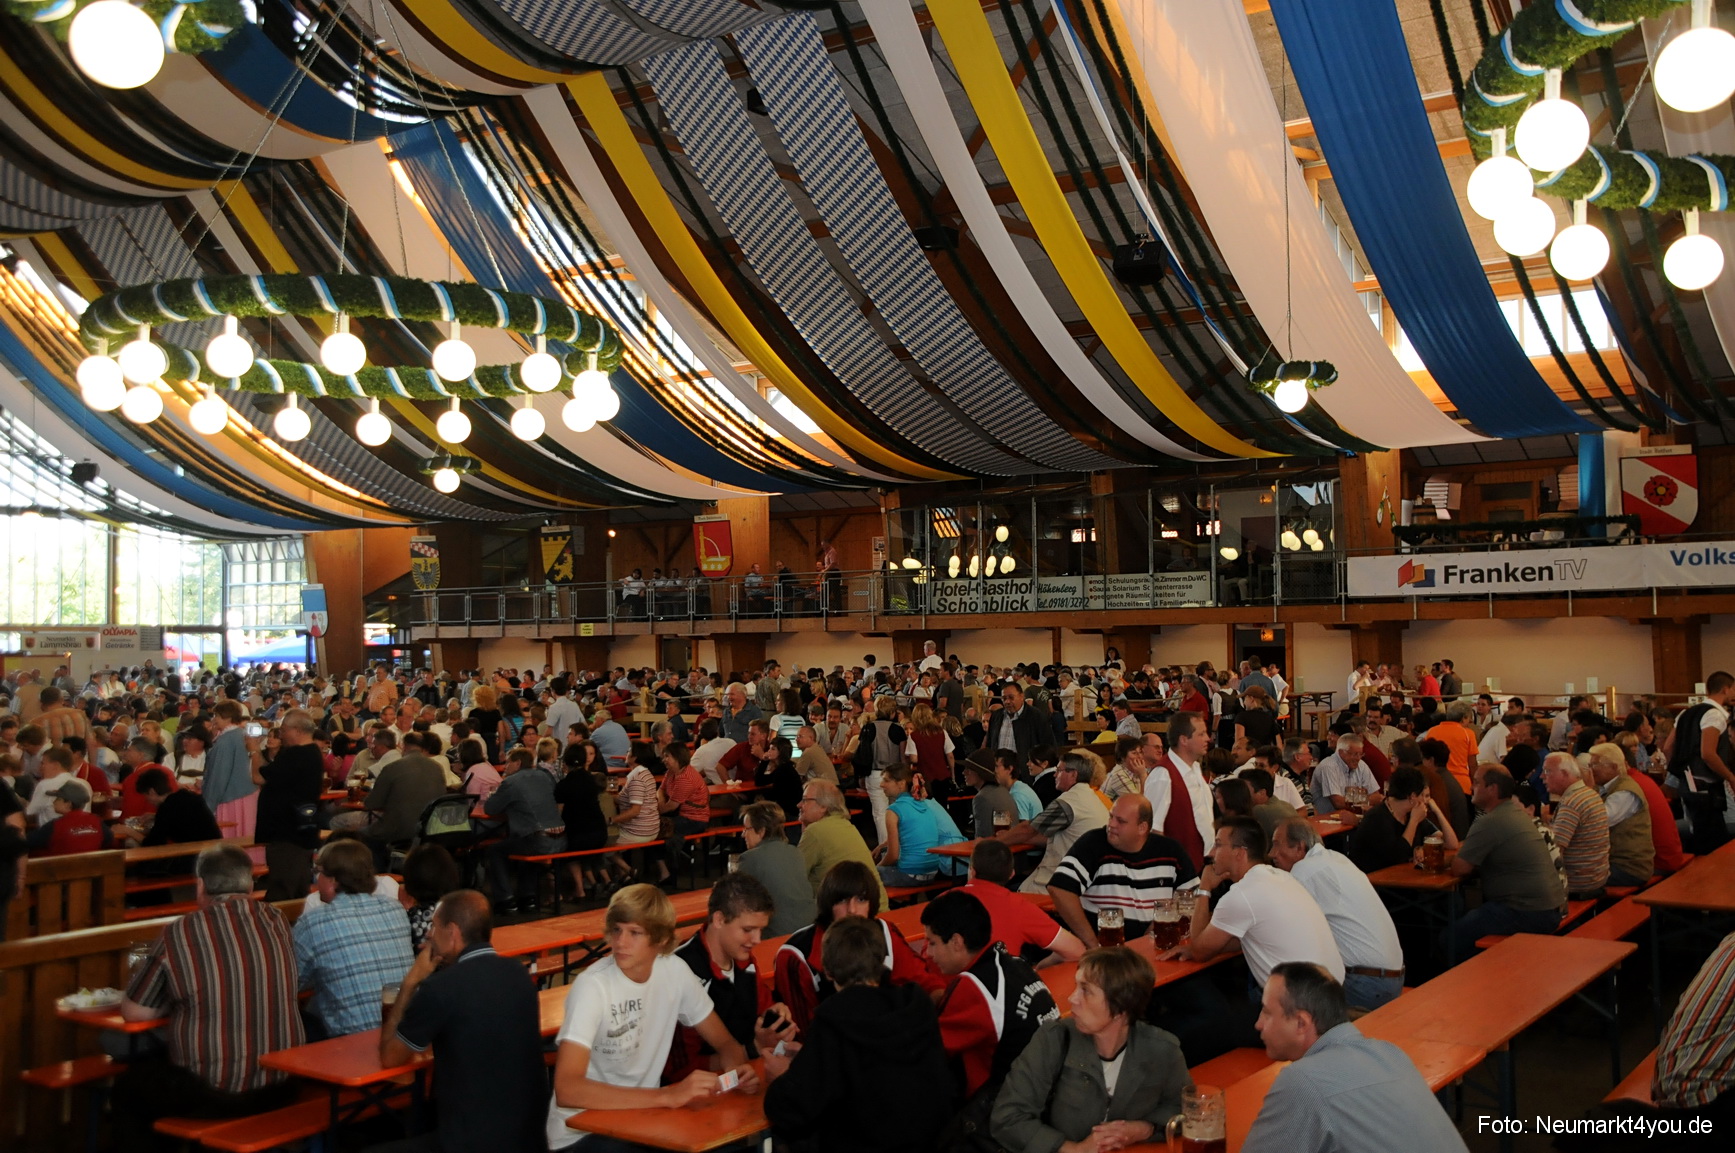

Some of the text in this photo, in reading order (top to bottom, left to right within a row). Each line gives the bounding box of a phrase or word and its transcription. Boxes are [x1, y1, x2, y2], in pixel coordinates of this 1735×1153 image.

[1093, 593, 1124, 601] geegnete
[936, 596, 1030, 613] Schönblick
[102, 626, 138, 636] OLYMPIA
[1015, 992, 1032, 1020] JFG
